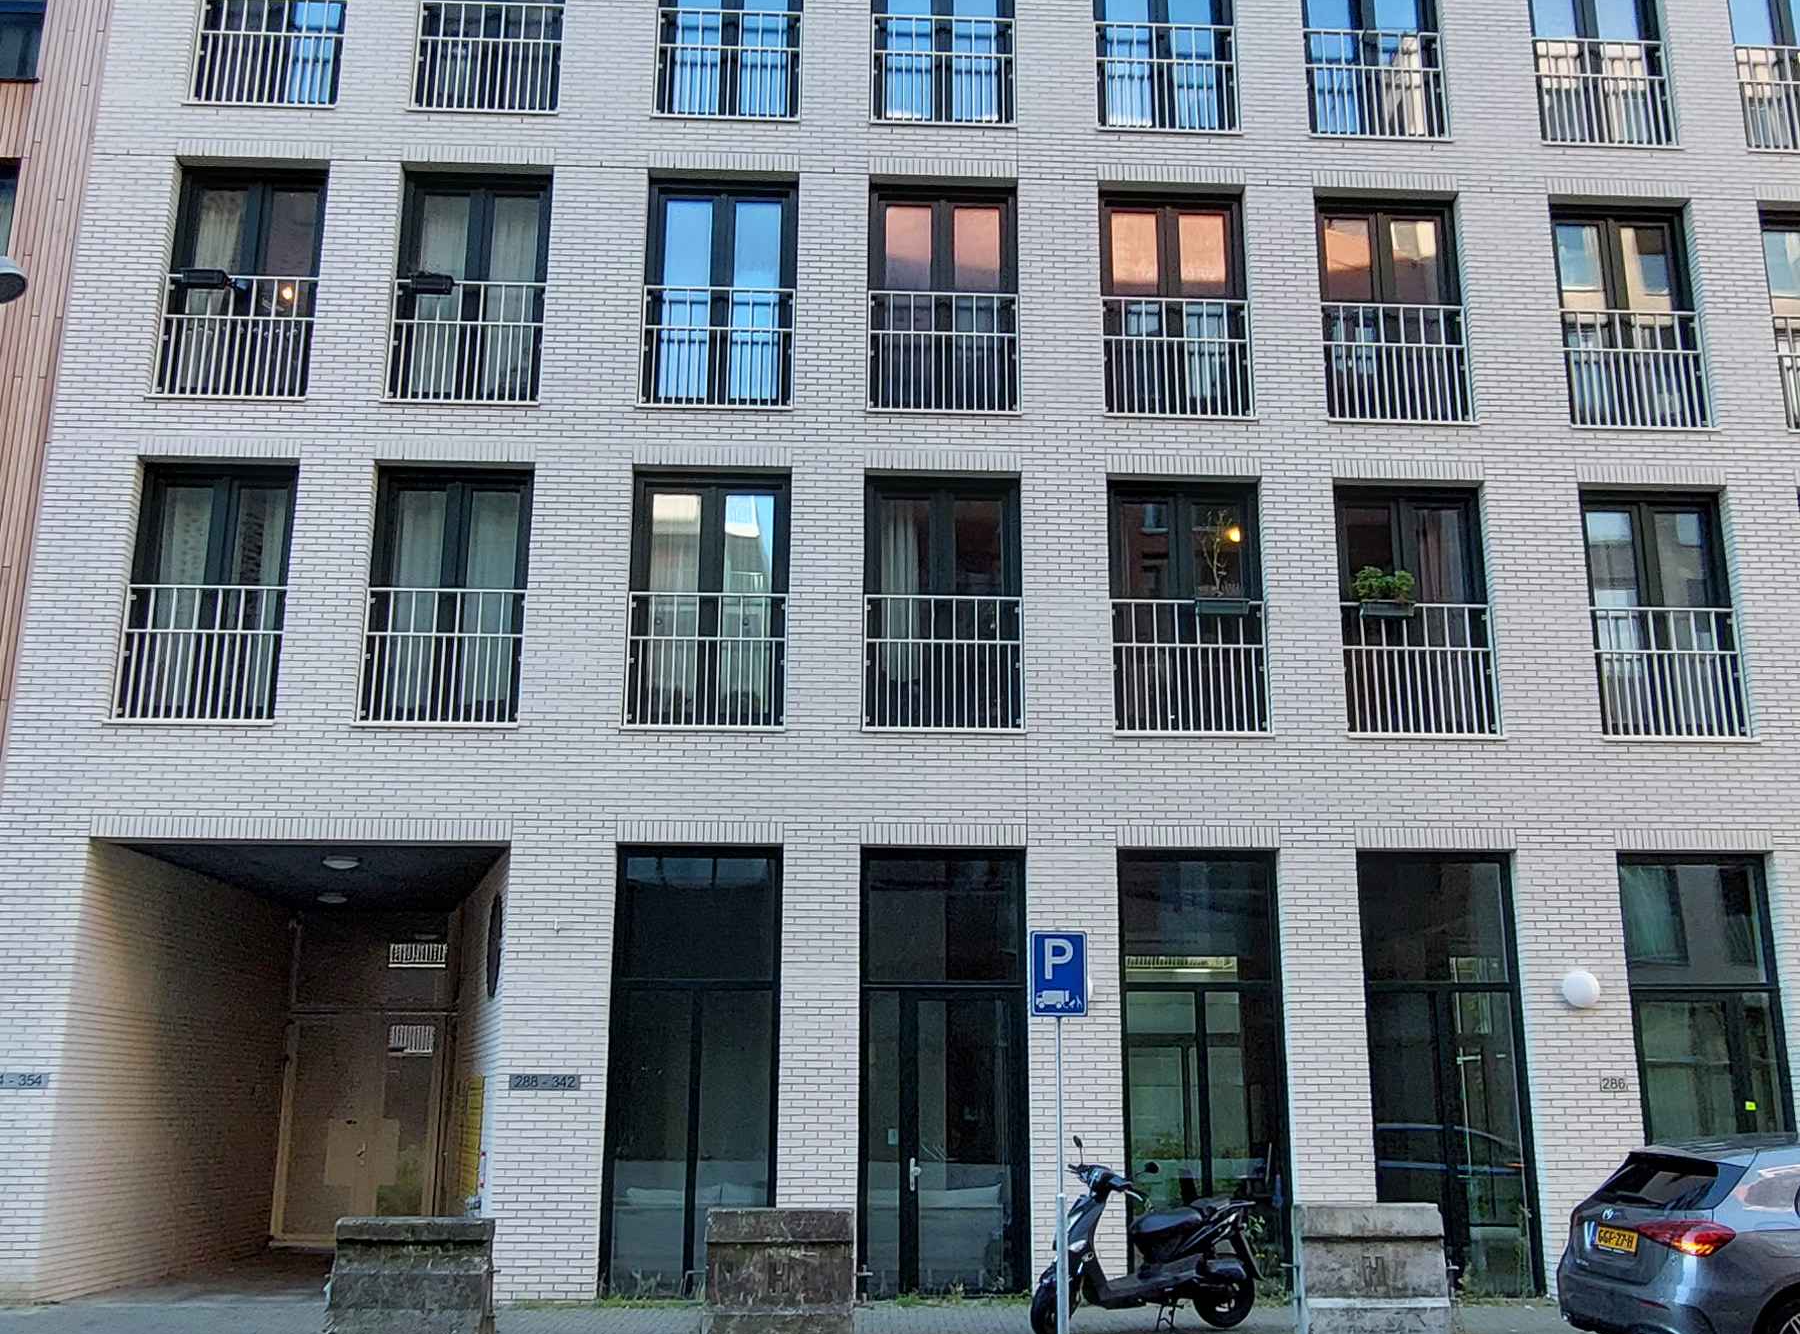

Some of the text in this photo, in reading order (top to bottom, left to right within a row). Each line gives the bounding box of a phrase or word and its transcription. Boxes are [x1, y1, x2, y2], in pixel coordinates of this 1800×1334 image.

[1044, 938, 1074, 980] P
[18, 1074, 42, 1086] 354
[552, 1075, 576, 1088] 342
